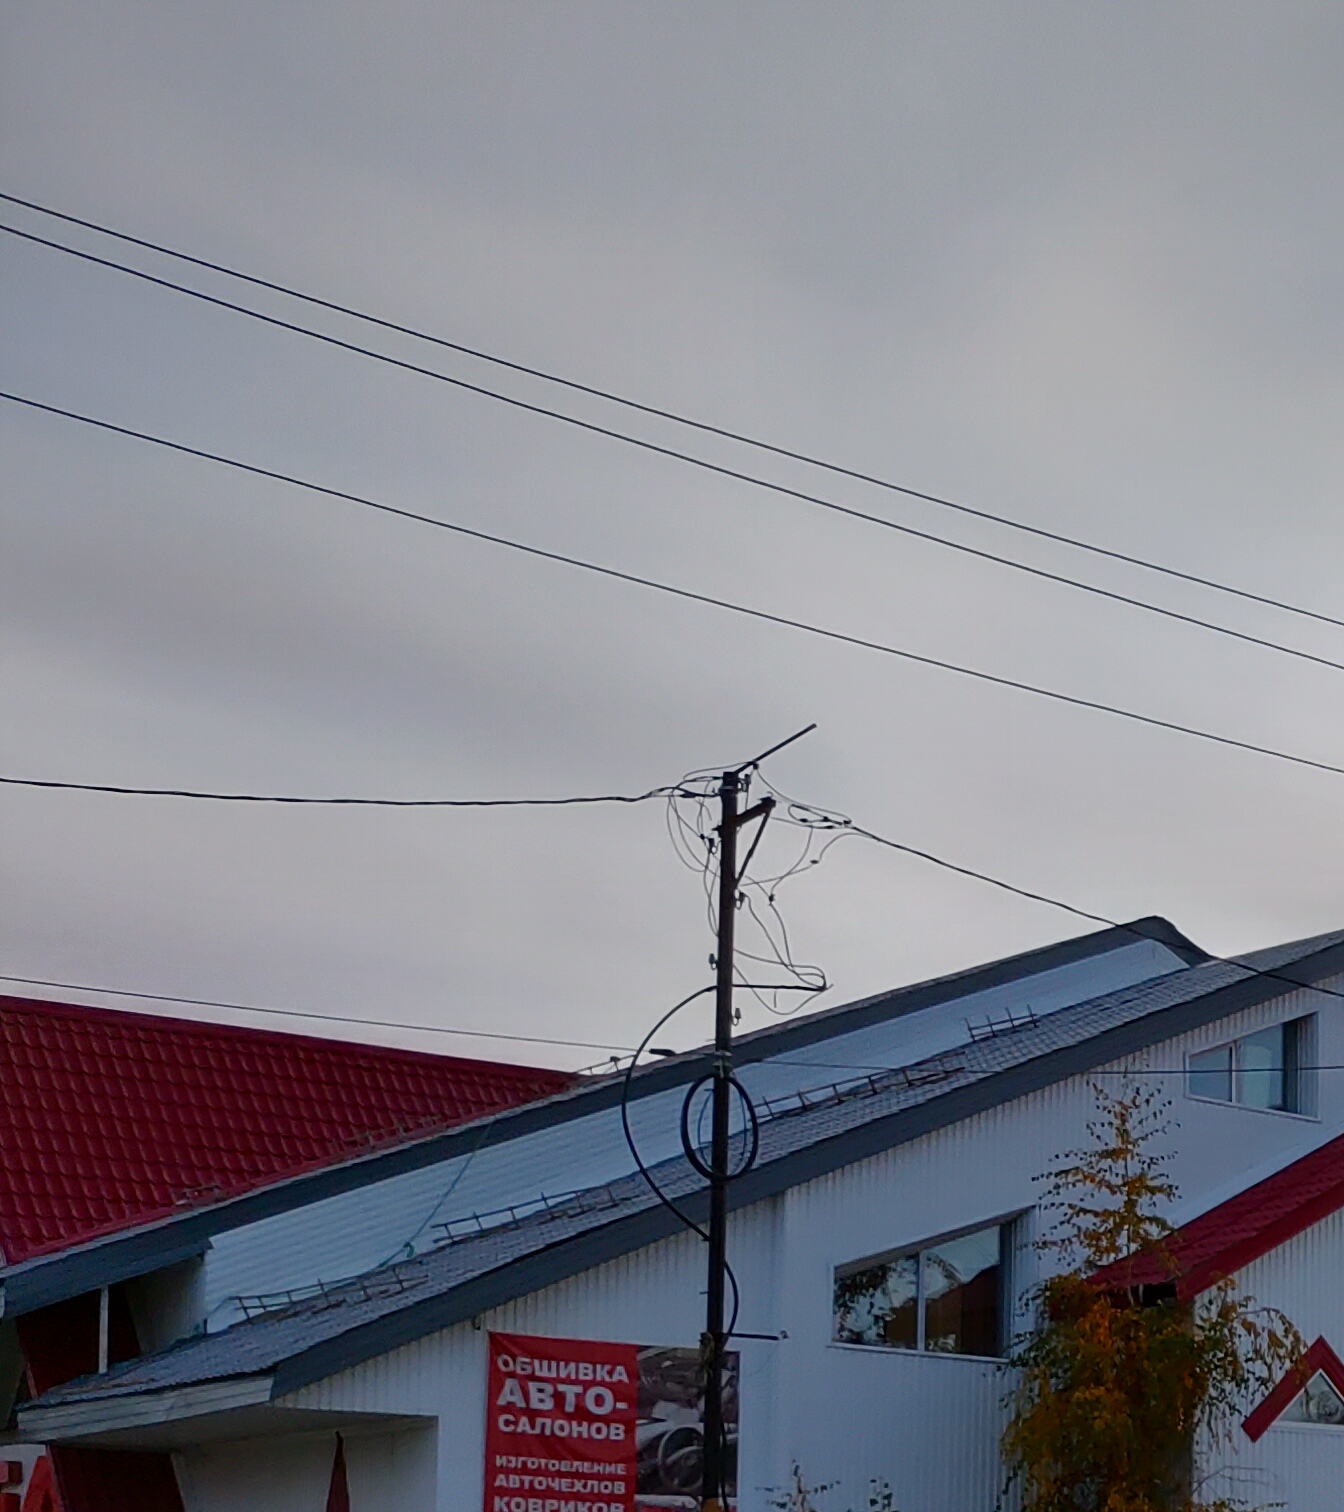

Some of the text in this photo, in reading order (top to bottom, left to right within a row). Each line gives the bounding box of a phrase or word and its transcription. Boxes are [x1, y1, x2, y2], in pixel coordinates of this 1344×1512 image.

[497, 1353, 629, 1384] ОБШИВКА
[496, 1377, 629, 1416] АВТО-
[498, 1413, 626, 1441] САЛОНОВ
[496, 1455, 627, 1476] ИЗГОТОВЛЕНИЕ
[494, 1473, 626, 1494] АВТОЧЕХЛОВ
